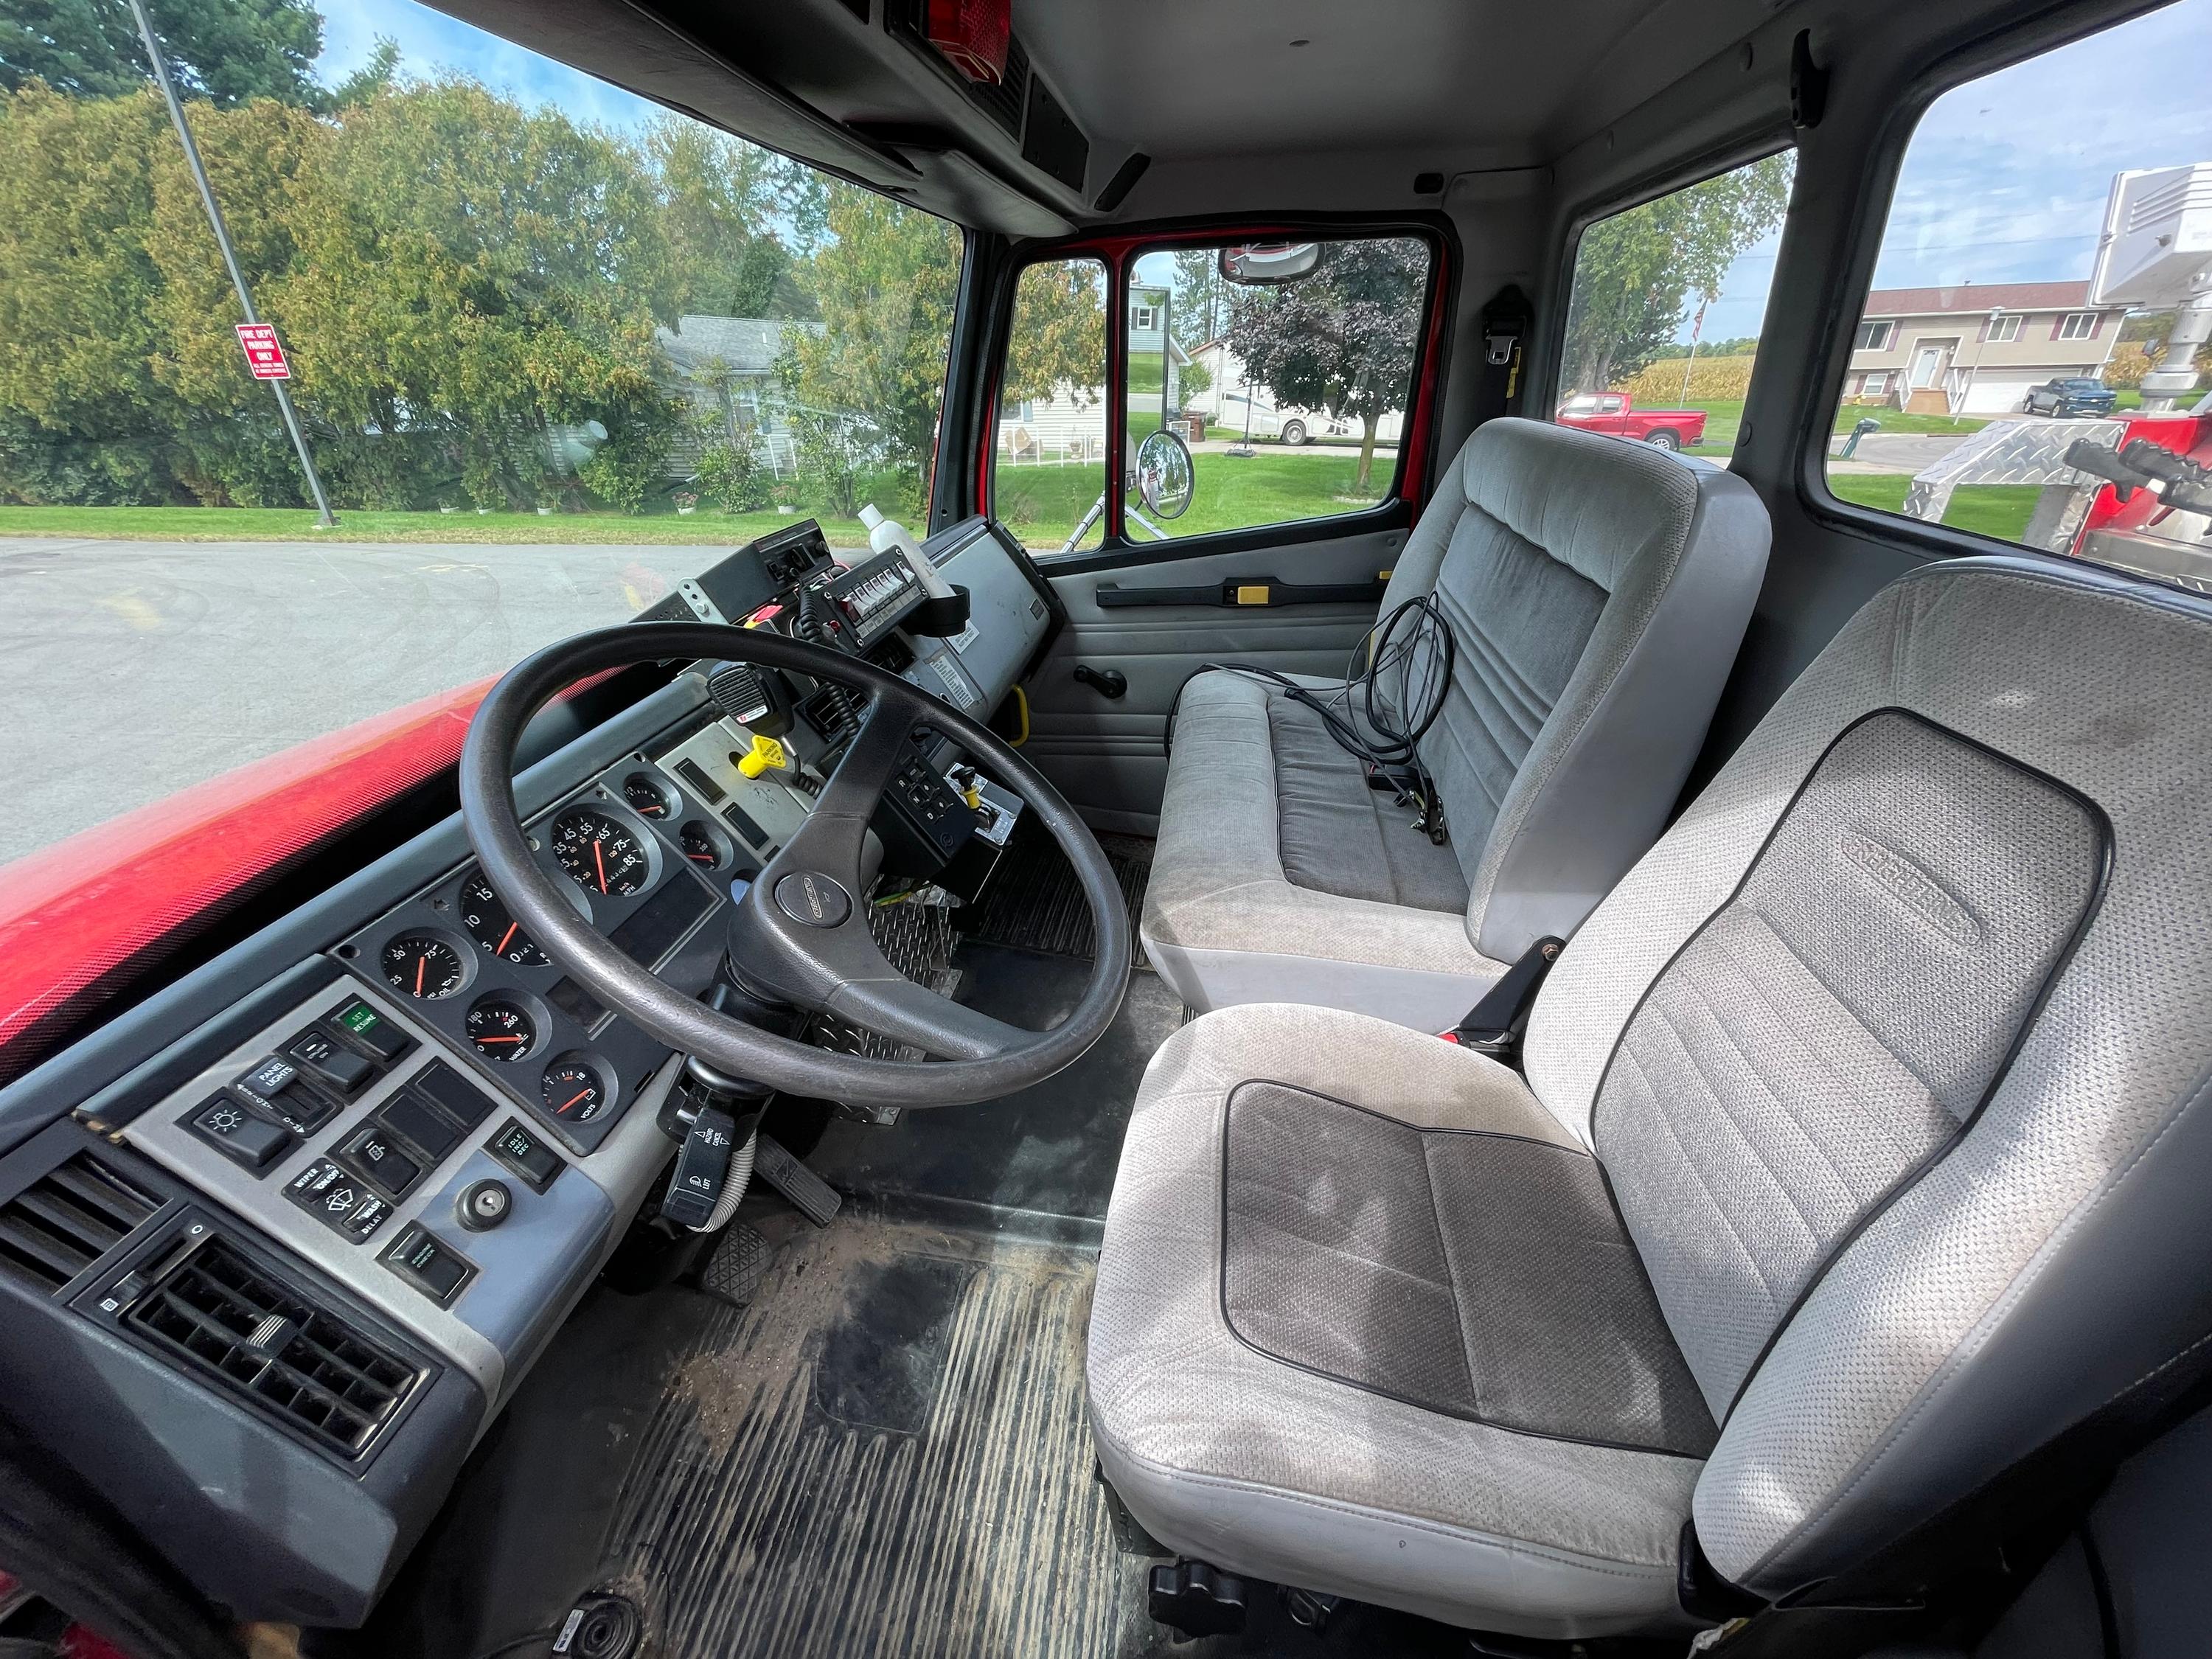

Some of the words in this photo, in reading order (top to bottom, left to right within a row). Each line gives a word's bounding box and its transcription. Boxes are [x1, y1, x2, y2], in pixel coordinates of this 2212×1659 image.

[240, 330, 256, 338] FIRE
[255, 330, 273, 338] DEPT
[247, 341, 274, 349] PARKING
[257, 352, 273, 361] ONLY
[762, 742, 777, 758] PARKING
[898, 779, 905, 787] R
[564, 828, 577, 841] 45
[580, 822, 593, 835] 55
[598, 827, 611, 840] 65
[553, 841, 567, 854] 35
[613, 839, 627, 852] 75
[622, 854, 636, 866] 85
[476, 888, 493, 901] 15
[622, 885, 636, 897] MPH
[464, 914, 481, 928] 10
[481, 941, 493, 951] 5
[393, 950, 406, 960] 50
[425, 949, 437, 959] 75
[509, 953, 521, 962] 0
[390, 975, 403, 985] 25
[439, 987, 451, 996] OIL
[352, 1012, 364, 1022] SET
[353, 1013, 377, 1032] RESUME
[468, 1011, 481, 1023] 180
[504, 1015, 518, 1028] 260
[509, 1046, 526, 1061] WATER
[259, 1062, 285, 1081] PANEL
[265, 1066, 293, 1087] LIGHTS
[576, 1071, 586, 1081] 18
[580, 1103, 596, 1119] VOLTS
[508, 1133, 522, 1148] IDLE
[512, 1138, 525, 1152] INC/
[518, 1144, 529, 1155] DEC
[294, 1168, 319, 1188] WIPER
[316, 1169, 340, 1189] ON/OFF
[361, 1200, 382, 1219] WASH
[361, 1214, 382, 1234] DELAY
